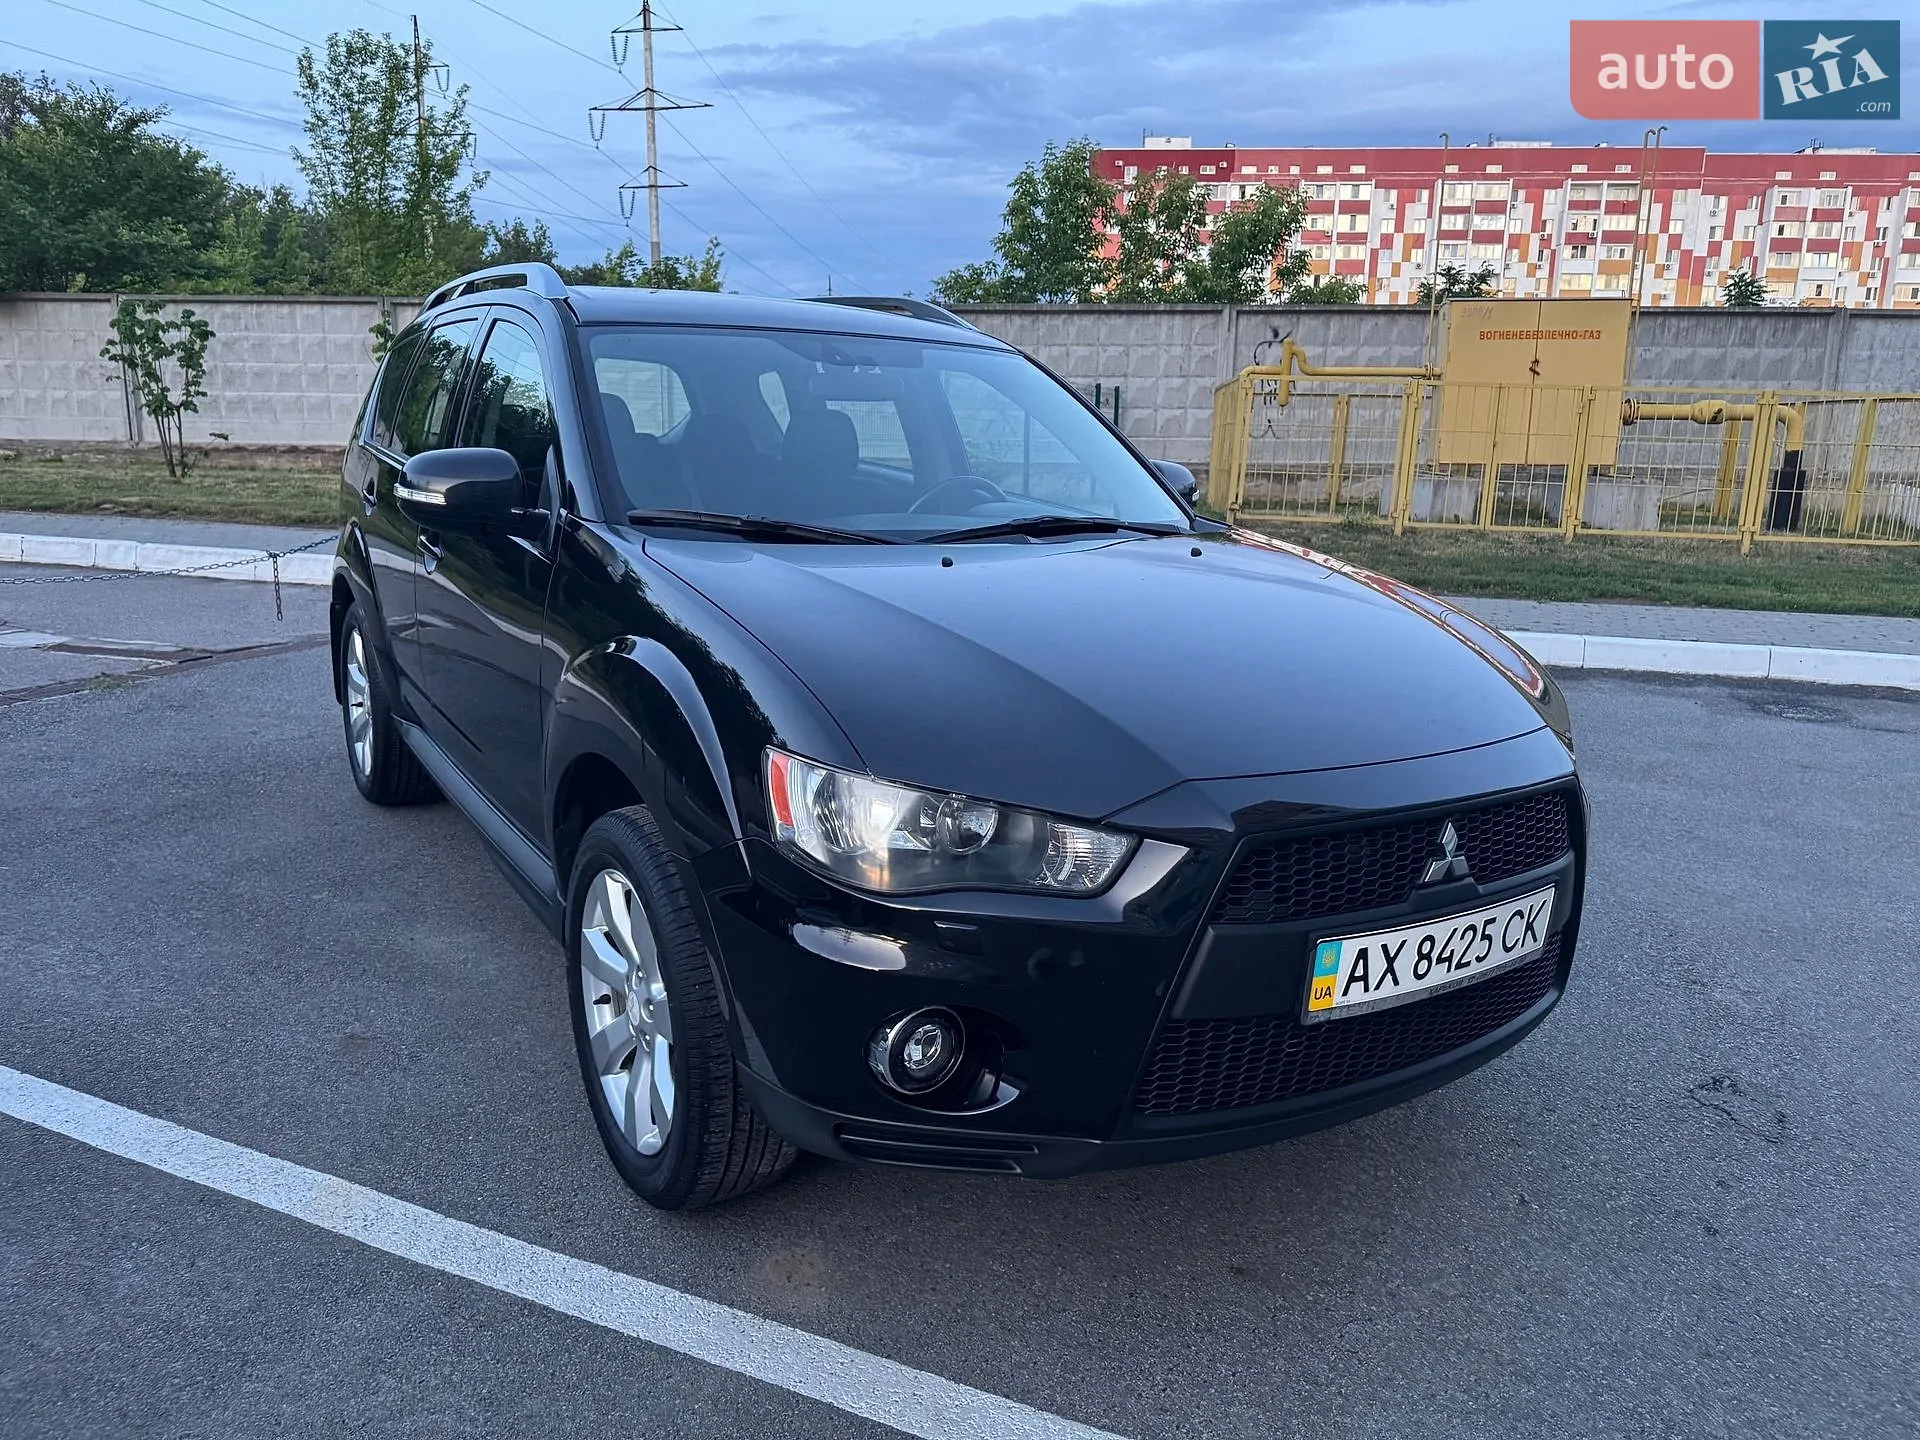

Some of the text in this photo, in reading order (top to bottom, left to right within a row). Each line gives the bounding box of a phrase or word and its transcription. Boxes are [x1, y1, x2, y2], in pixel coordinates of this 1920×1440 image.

[1479, 330, 1602, 341] ВОГНЕНЕБЕЗПЕЧНО-ГАЗ
[1341, 938, 1407, 997] AX
[1411, 917, 1497, 981] 8425
[1501, 899, 1548, 954] CK
[1313, 986, 1332, 1000] UA
